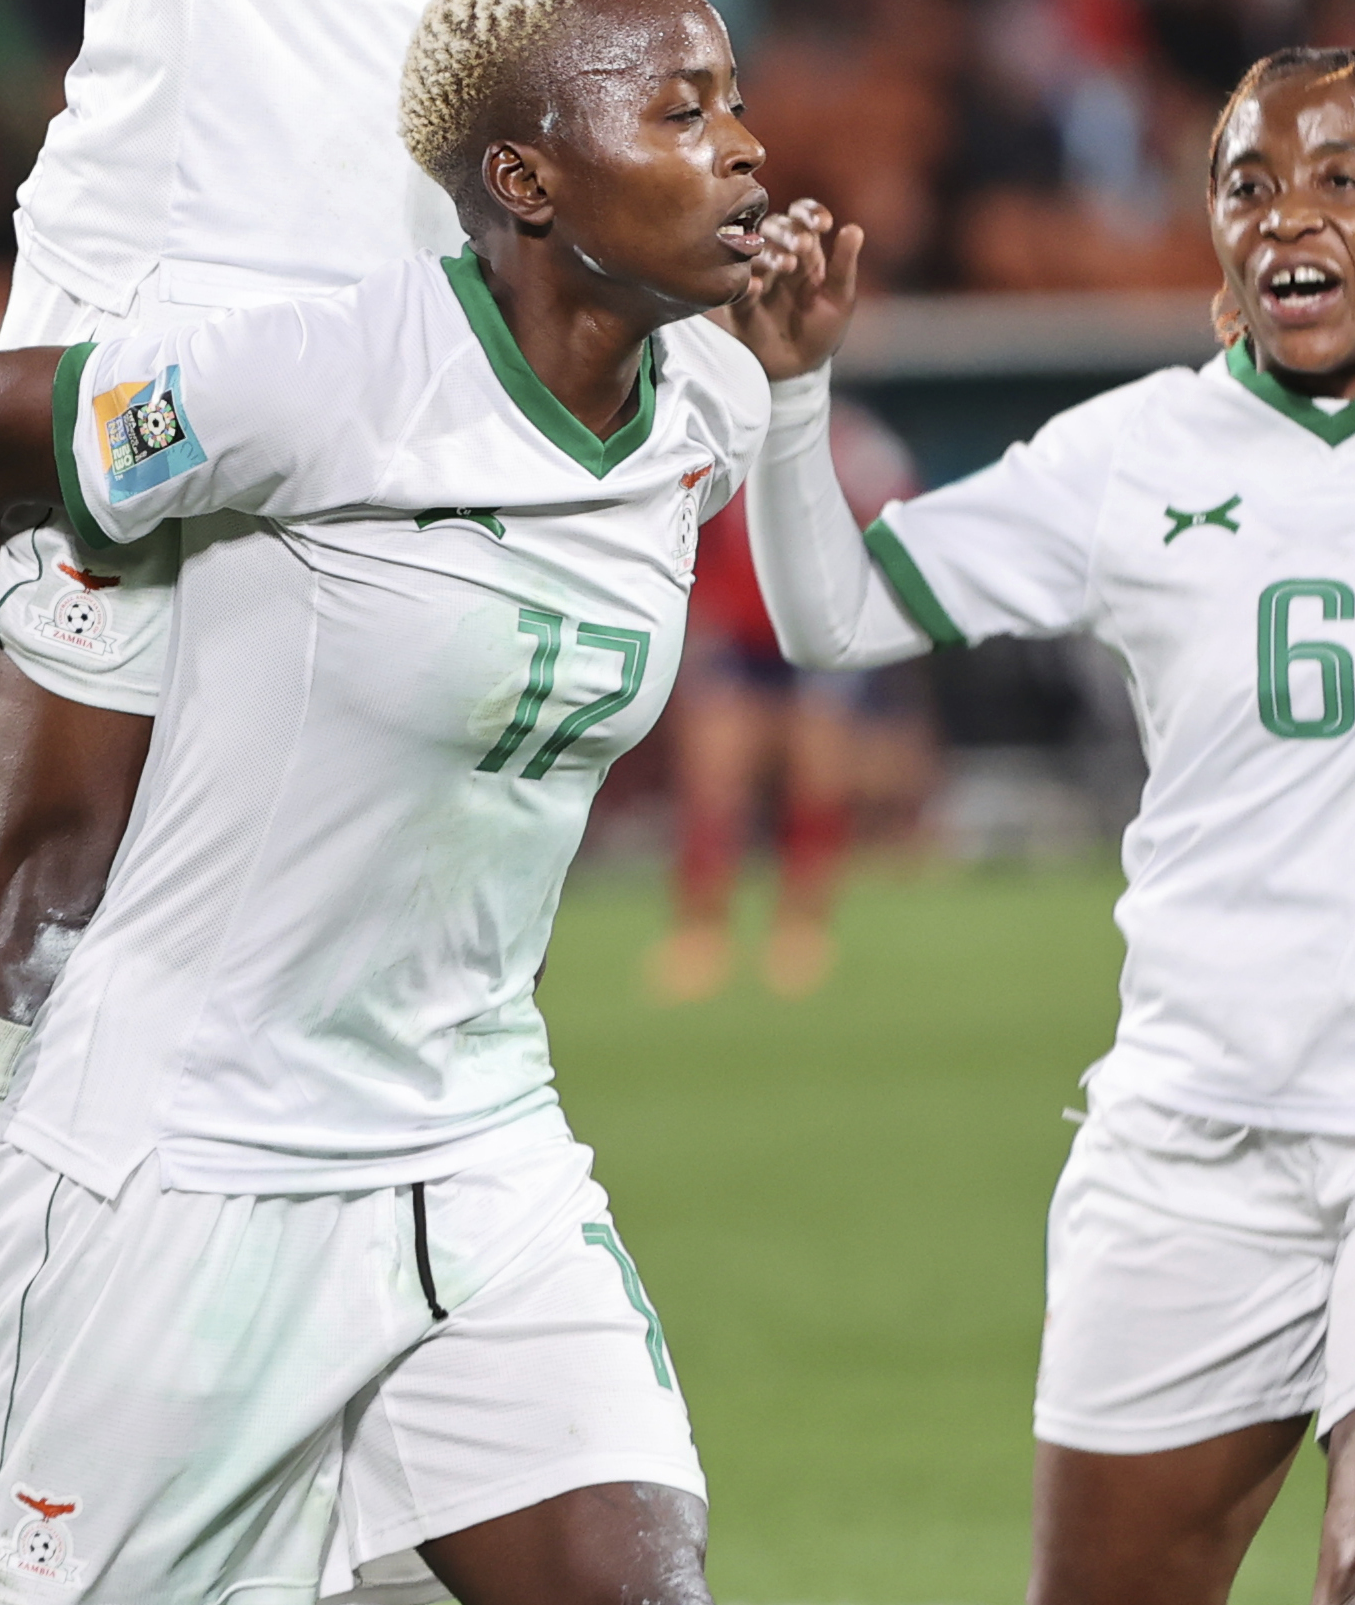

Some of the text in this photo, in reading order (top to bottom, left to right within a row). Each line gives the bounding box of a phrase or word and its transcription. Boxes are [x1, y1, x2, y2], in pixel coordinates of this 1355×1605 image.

[53, 629, 93, 649] ZAMBIA
[1257, 578, 1355, 738] 6
[475, 607, 651, 781] 17
[18, 1561, 56, 1578] ZAMBIA
